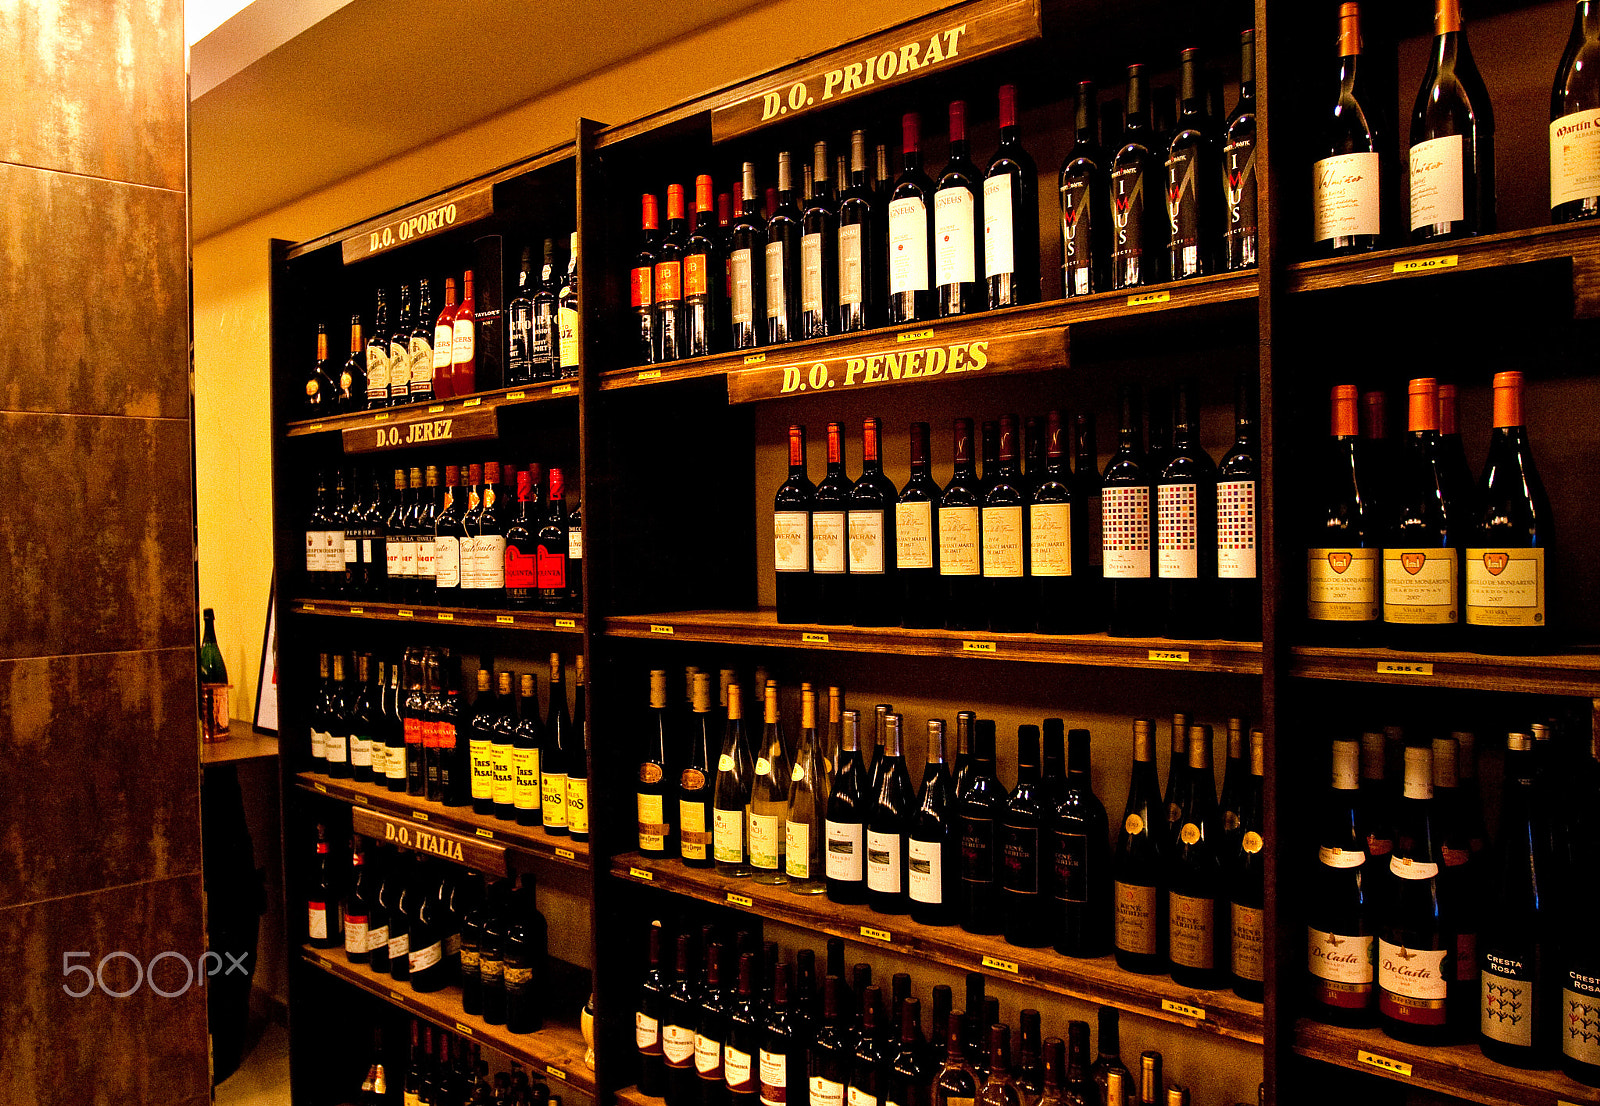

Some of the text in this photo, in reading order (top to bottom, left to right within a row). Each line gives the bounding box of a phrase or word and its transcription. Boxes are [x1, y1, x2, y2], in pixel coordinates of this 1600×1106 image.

[761, 23, 966, 121] D.O. PRIORAT
[370, 204, 457, 252] D.O. OPORTO
[1404, 260, 1436, 268] 10.40
[474, 310, 500, 318] TAYLOR'S
[780, 342, 989, 393] D.O. PENEDES
[376, 419, 452, 448] D.O. JEREZ
[1155, 652, 1182, 660] 7.75€
[516, 776, 537, 786] PASAS
[715, 821, 726, 829] ACH
[751, 826, 762, 834] ACH
[385, 822, 464, 862] D.O. ITALIA
[1486, 954, 1522, 968] CRESTA
[1491, 962, 1516, 975] ROSA
[1569, 971, 1600, 984] CREST
[1389, 994, 1428, 1008] ORRES
